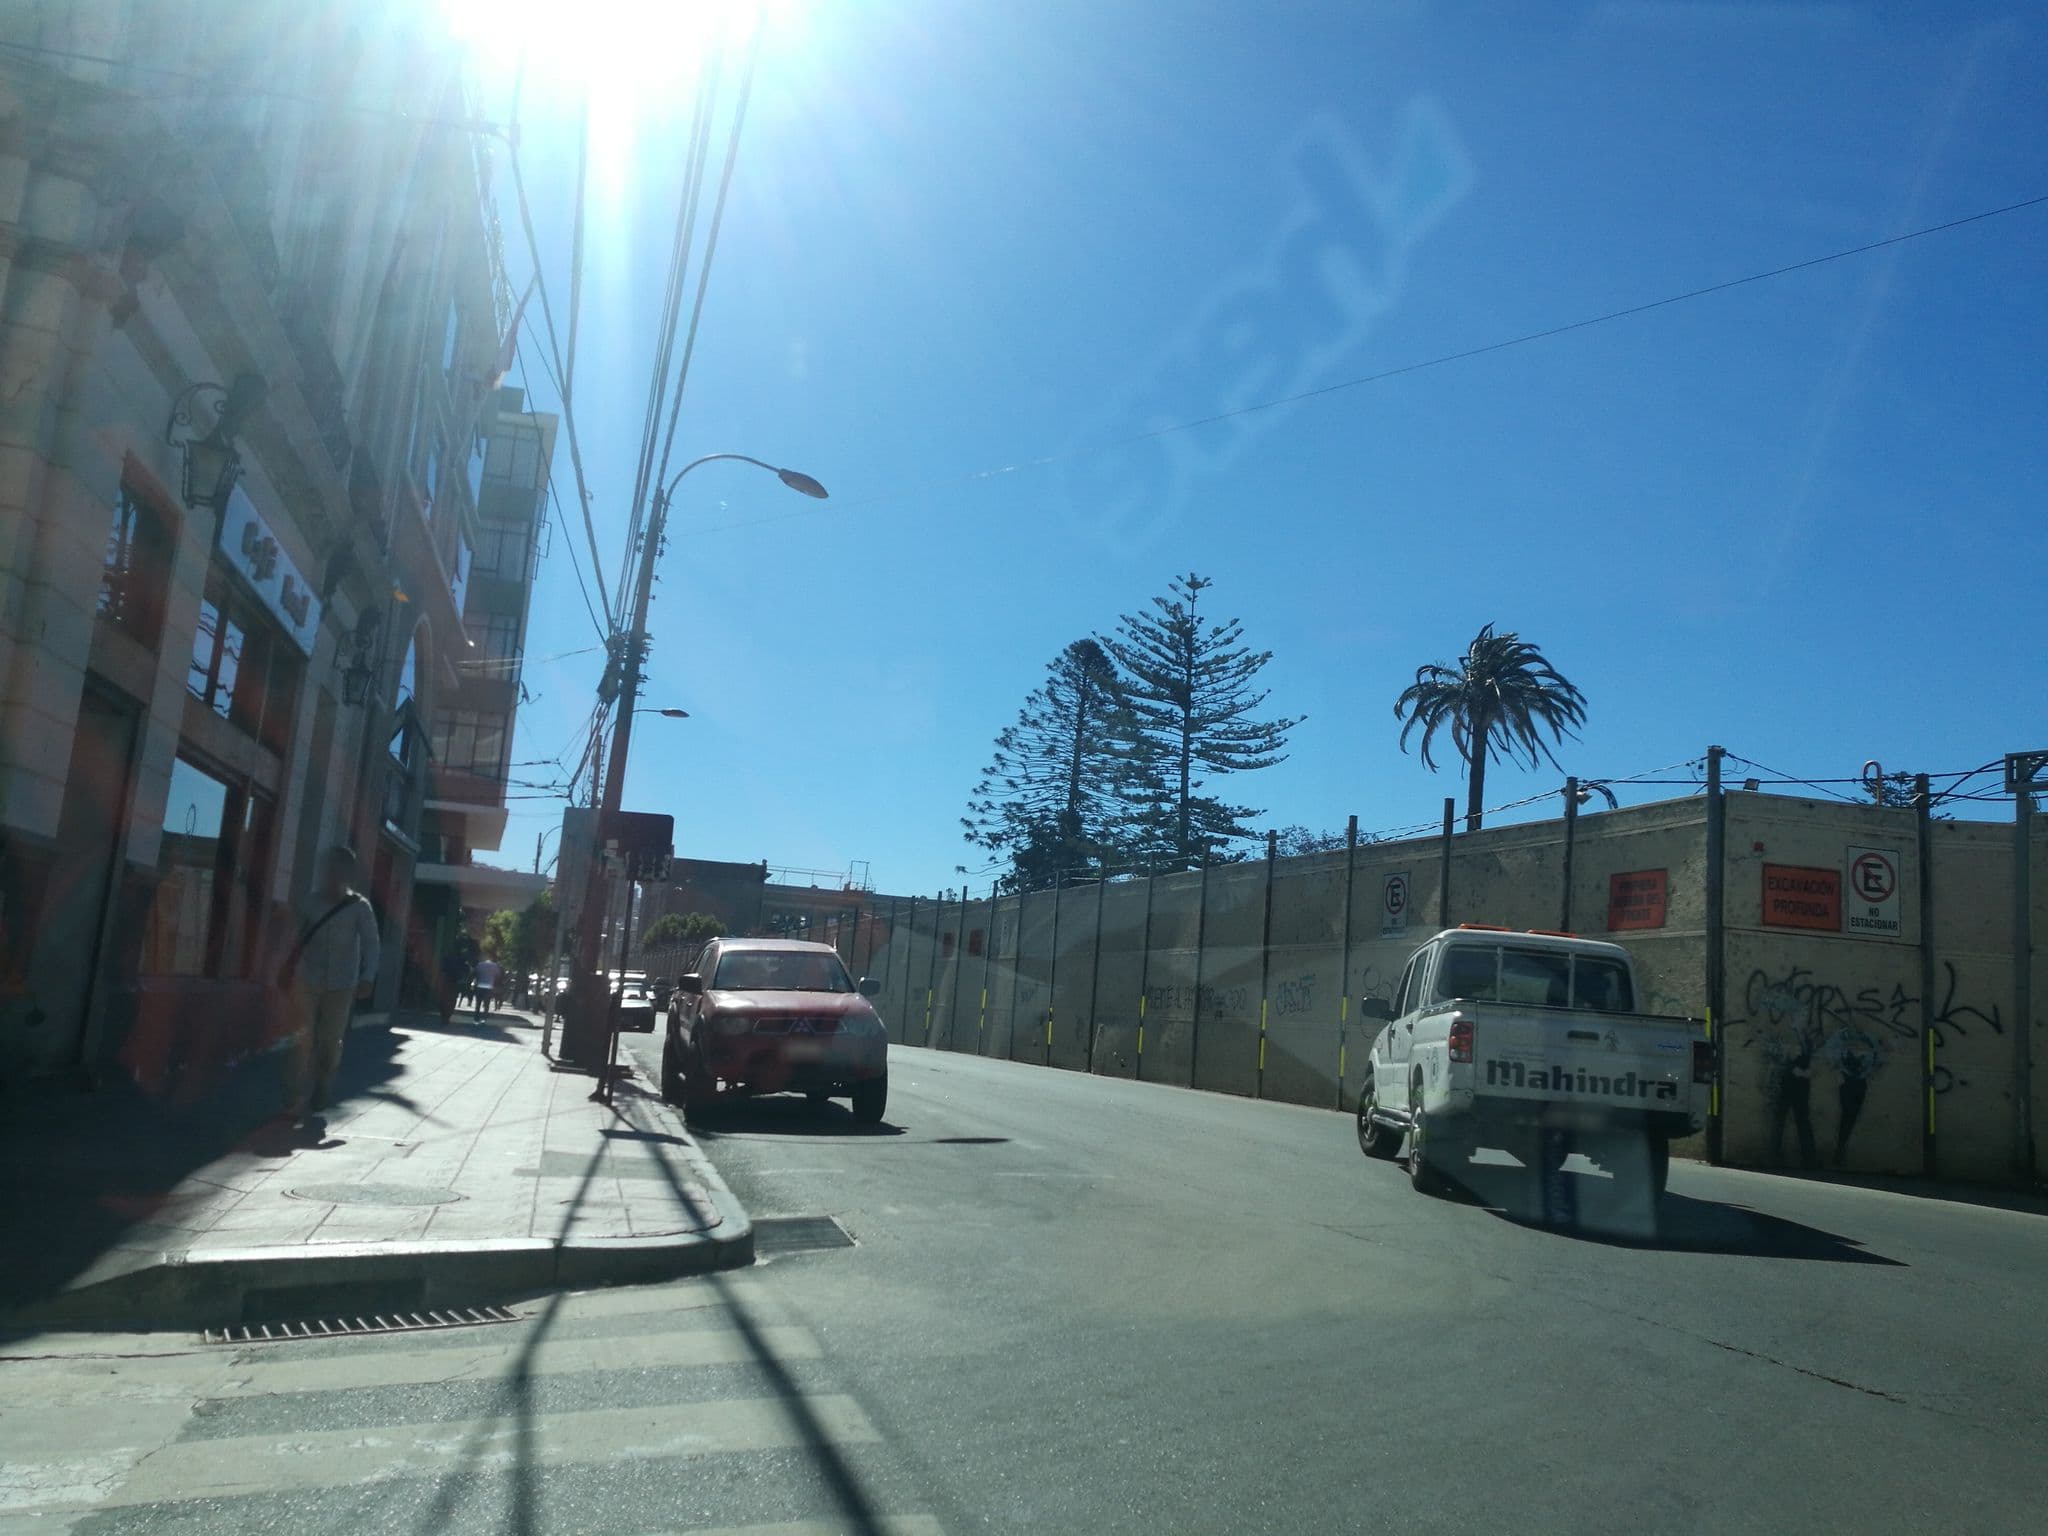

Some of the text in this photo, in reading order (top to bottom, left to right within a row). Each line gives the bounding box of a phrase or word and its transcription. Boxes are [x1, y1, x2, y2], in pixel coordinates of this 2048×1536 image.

[1862, 862, 1884, 893] E
[1868, 906, 1880, 917] NO
[1850, 916, 1899, 931] ESTACIONAR
